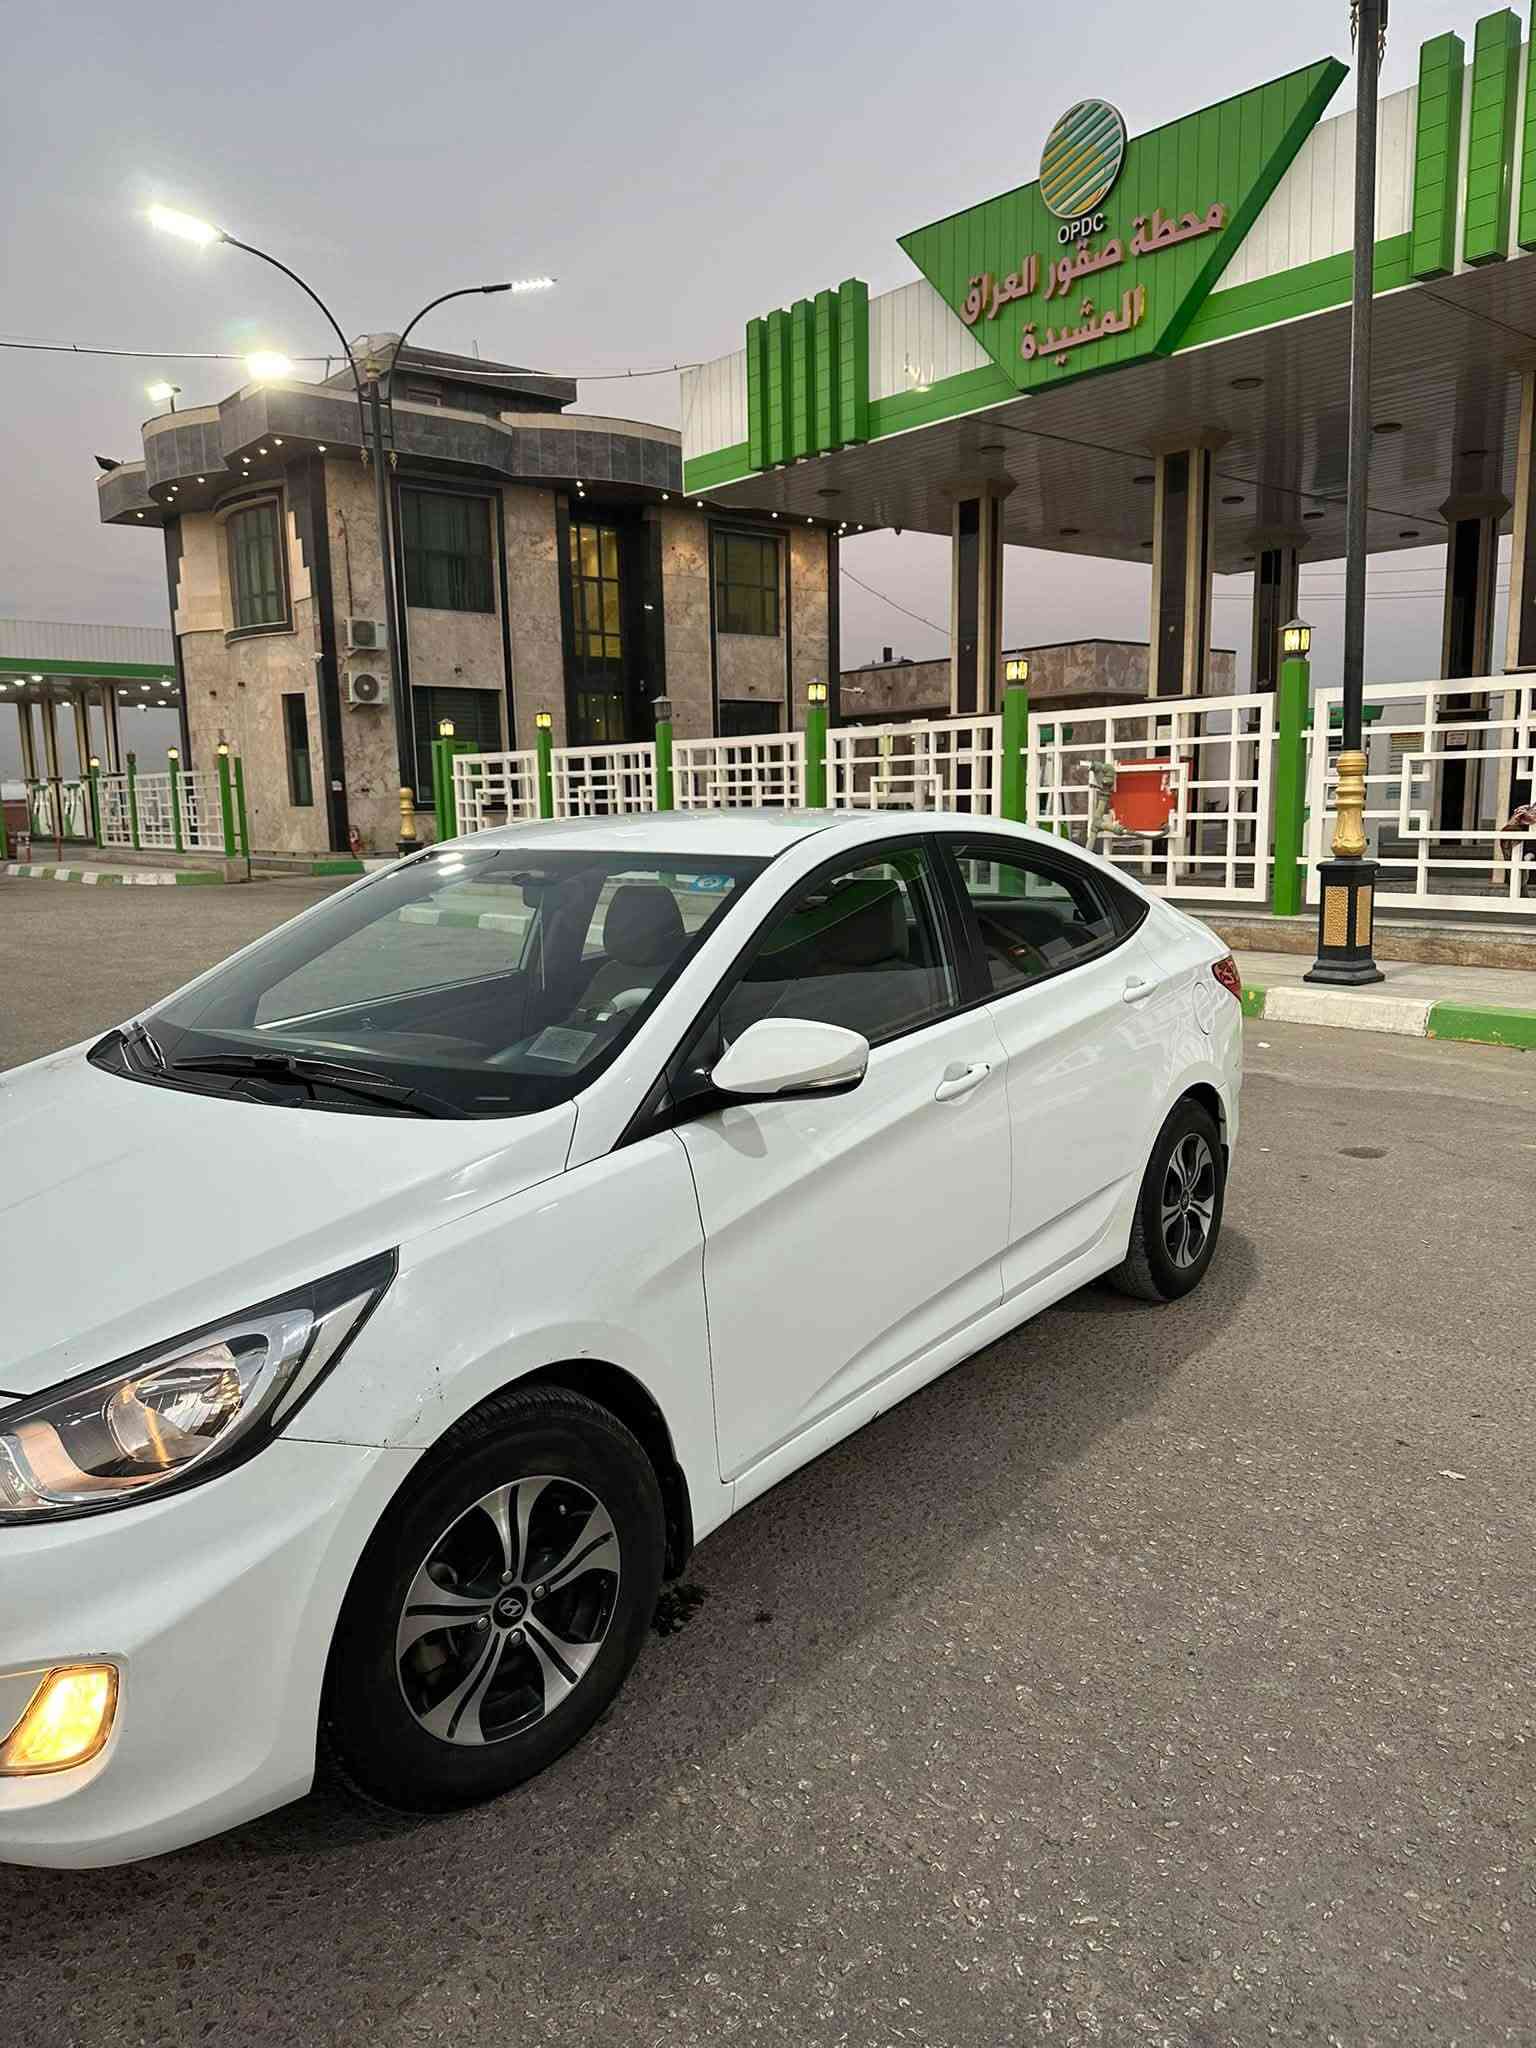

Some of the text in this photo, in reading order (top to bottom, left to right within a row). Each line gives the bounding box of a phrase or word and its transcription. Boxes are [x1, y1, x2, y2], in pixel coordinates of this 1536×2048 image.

[960, 202, 1225, 325] محطة صقور العراق
[1057, 212, 1105, 244] OPDC
[1021, 283, 1146, 367] المشيدة
